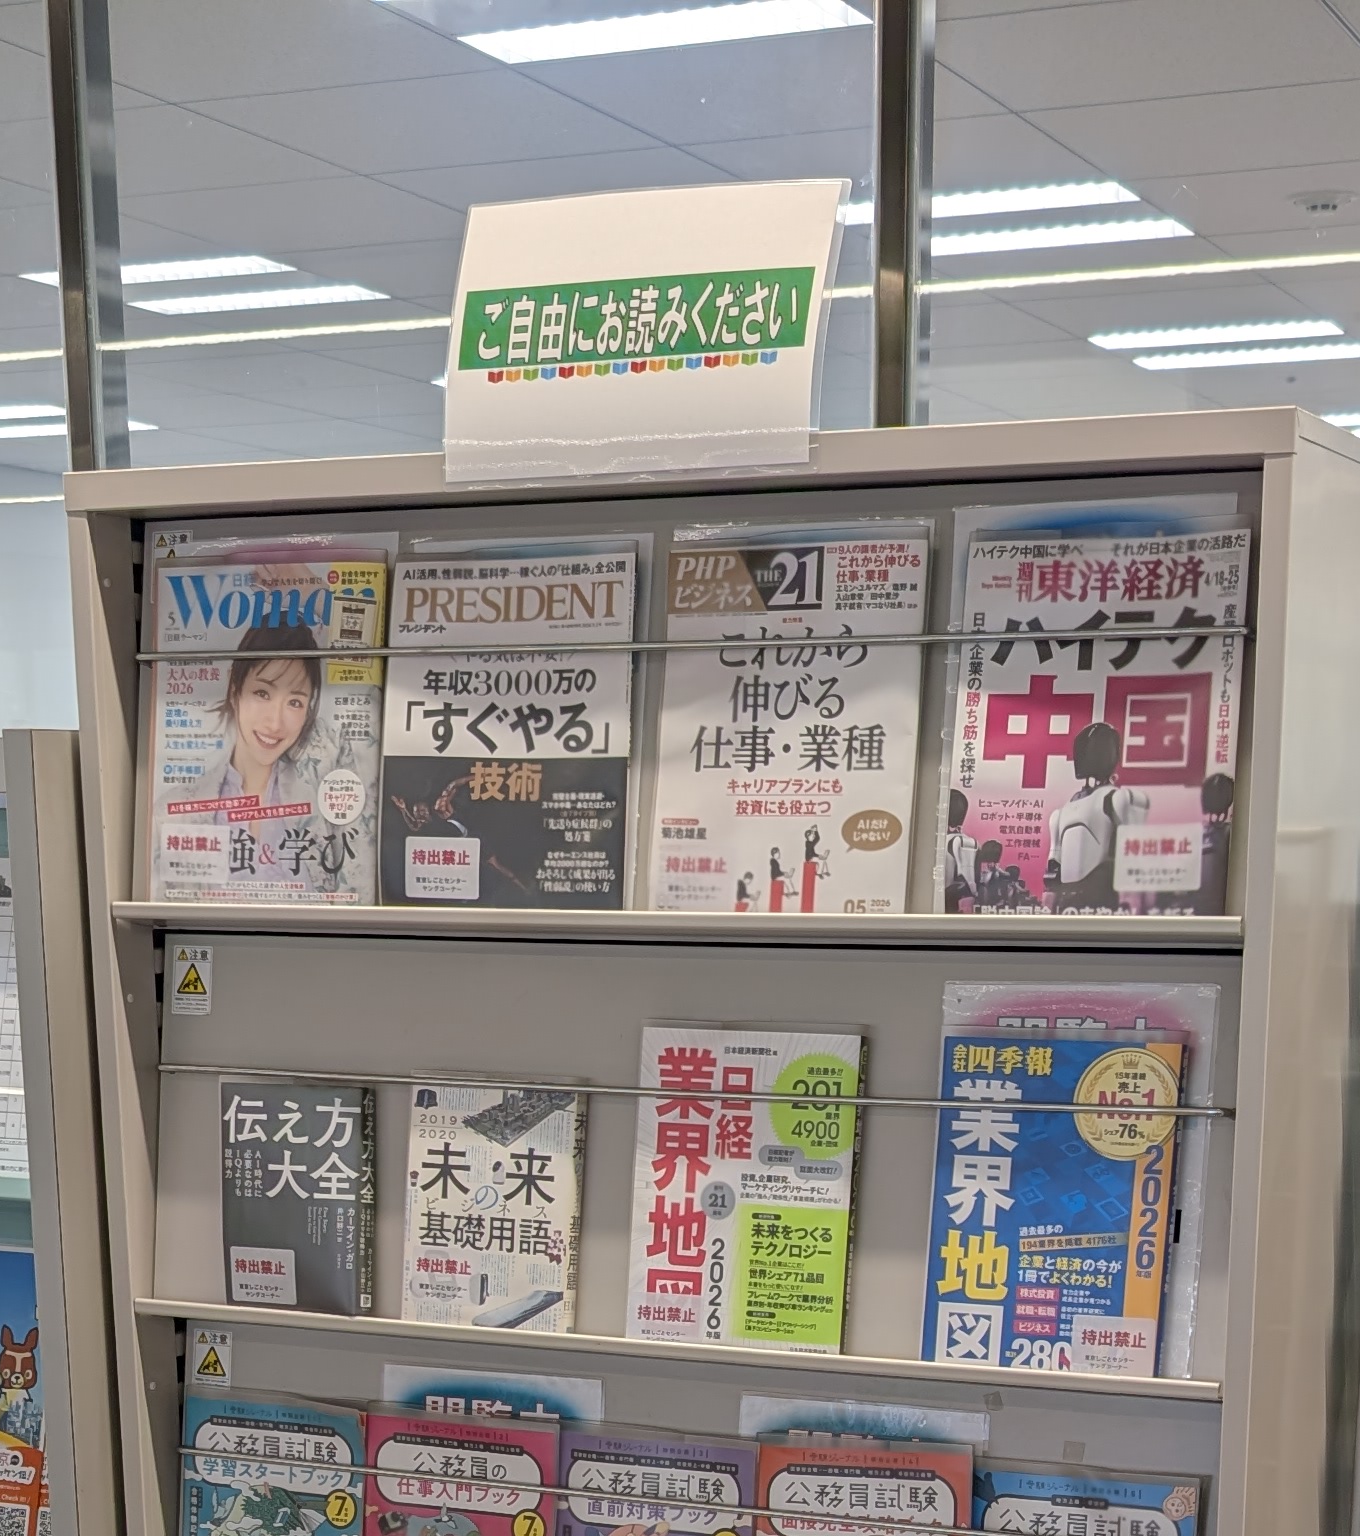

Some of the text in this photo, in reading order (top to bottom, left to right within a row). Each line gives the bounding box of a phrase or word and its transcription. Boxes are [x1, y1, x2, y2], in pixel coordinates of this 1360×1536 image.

[477, 279, 798, 365] ご自由にお読みください
[973, 543, 1084, 560] ハイテク中国に学べ
[1111, 533, 1246, 558] それが日本企業の活路だ
[676, 555, 737, 581] PHP
[837, 553, 921, 569] これから伸びる
[755, 569, 783, 583] THE
[767, 551, 820, 606] 21
[1016, 561, 1034, 602] 週刊
[1036, 556, 1205, 603] 東洋経済
[403, 580, 625, 624] PRESIDENT
[674, 584, 752, 610] ビジネス
[398, 624, 447, 634] プレジデント
[990, 606, 1217, 671] ハイテク
[166, 682, 193, 695] 2026
[423, 668, 597, 697] 年収3000万の
[731, 674, 846, 722] 伸びる
[405, 700, 609, 755] 「すぐやる」
[982, 672, 1214, 790] 中国
[690, 725, 887, 774] 仕事・業種
[469, 762, 543, 801] 技術
[727, 778, 844, 794] キャリアプランにも
[736, 800, 832, 816] 投資にも役立つ
[166, 834, 222, 852] 持出禁止
[999, 825, 1042, 836] 電気自動車
[1005, 838, 1041, 849] 工作機械
[412, 849, 470, 866] 持出禁止
[188, 949, 209, 961] 注意
[967, 1045, 1054, 1076] 四季報
[223, 1094, 362, 1148] 伝え方
[419, 1113, 459, 1126] 2019
[714, 1066, 755, 1161] 日経
[418, 1129, 458, 1141] 2020
[791, 1119, 840, 1140] 4900
[359, 1092, 376, 1204] 伝え方大全
[266, 1150, 360, 1201] 大全
[937, 1079, 1023, 1361] 業界地図
[1134, 1145, 1165, 1270] 2026
[418, 1210, 552, 1256] 基礎用語
[751, 1221, 833, 1243] 未来をつくる
[750, 1240, 832, 1260] テクノロジー
[235, 1257, 286, 1276] 持出禁止
[416, 1258, 471, 1277] 持出禁止
[1018, 1254, 1123, 1273] 企業と経済の今が
[705, 1237, 726, 1330] 2026
[1017, 1269, 1113, 1289] 1冊でよくわかる!
[637, 1304, 696, 1325] 持出禁止
[208, 1333, 229, 1345] 注意
[1018, 1322, 1052, 1334] ビジネス
[1081, 1329, 1147, 1350] 持出禁止
[208, 1431, 340, 1465] 公務員試験
[202, 1457, 345, 1489] 学習スタートブック
[413, 1450, 508, 1482] 公務員の
[581, 1468, 725, 1504] 公務員試験
[784, 1481, 939, 1512] 公務員試験
[586, 1498, 720, 1526] 直前対策ブック
